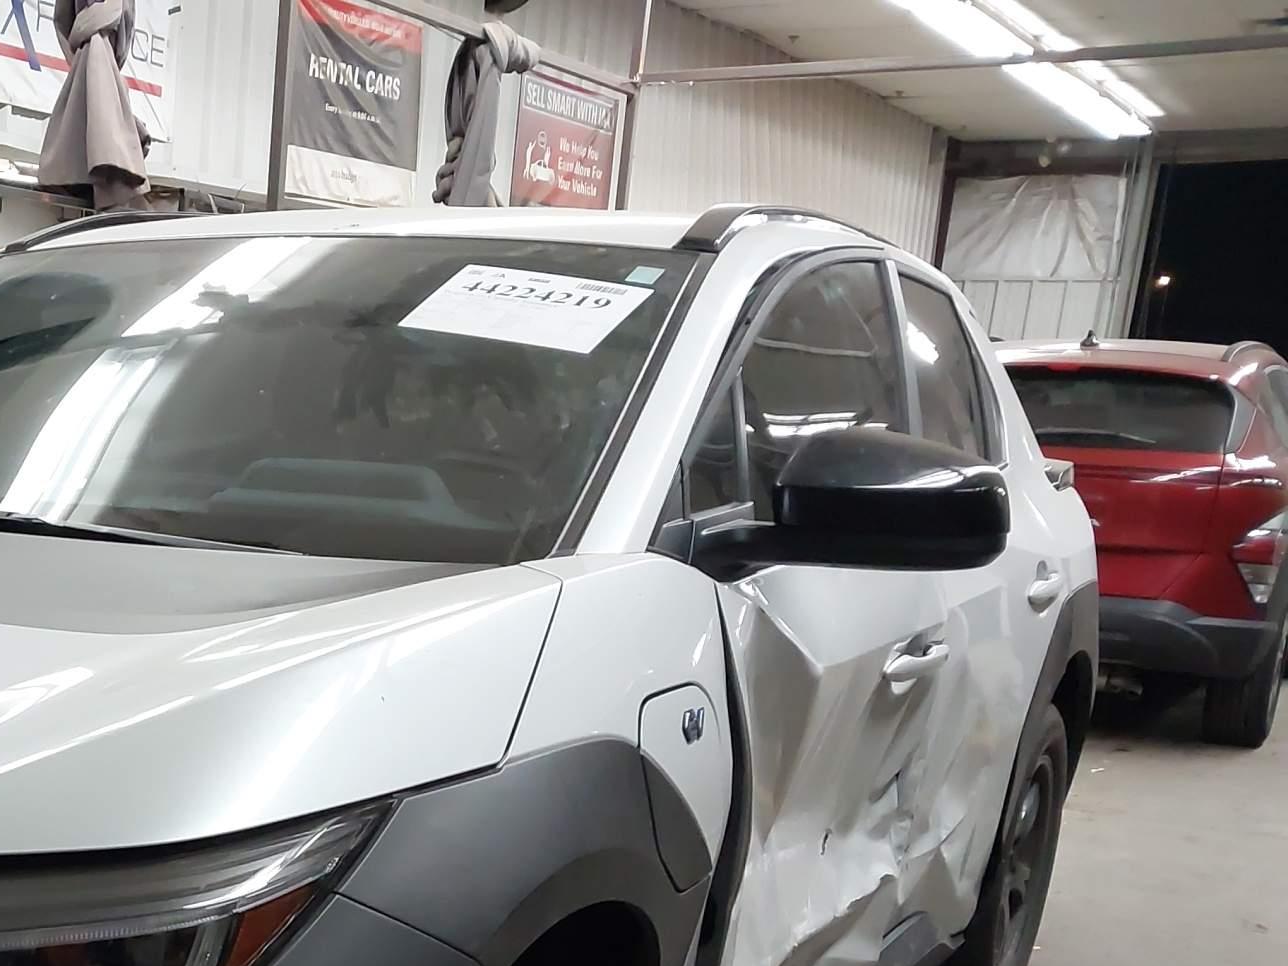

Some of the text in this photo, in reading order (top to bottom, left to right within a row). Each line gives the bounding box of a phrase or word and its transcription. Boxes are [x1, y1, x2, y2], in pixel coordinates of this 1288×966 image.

[308, 52, 401, 100] RENTAL CARS
[527, 83, 545, 108] SELL
[547, 90, 577, 118] SMART
[577, 99, 598, 126] WITH
[559, 137, 570, 153] We
[587, 145, 600, 161] You
[573, 160, 591, 178] More
[591, 165, 603, 180] For
[557, 175, 597, 197] Your Vehicle
[461, 280, 612, 310] 44224219
